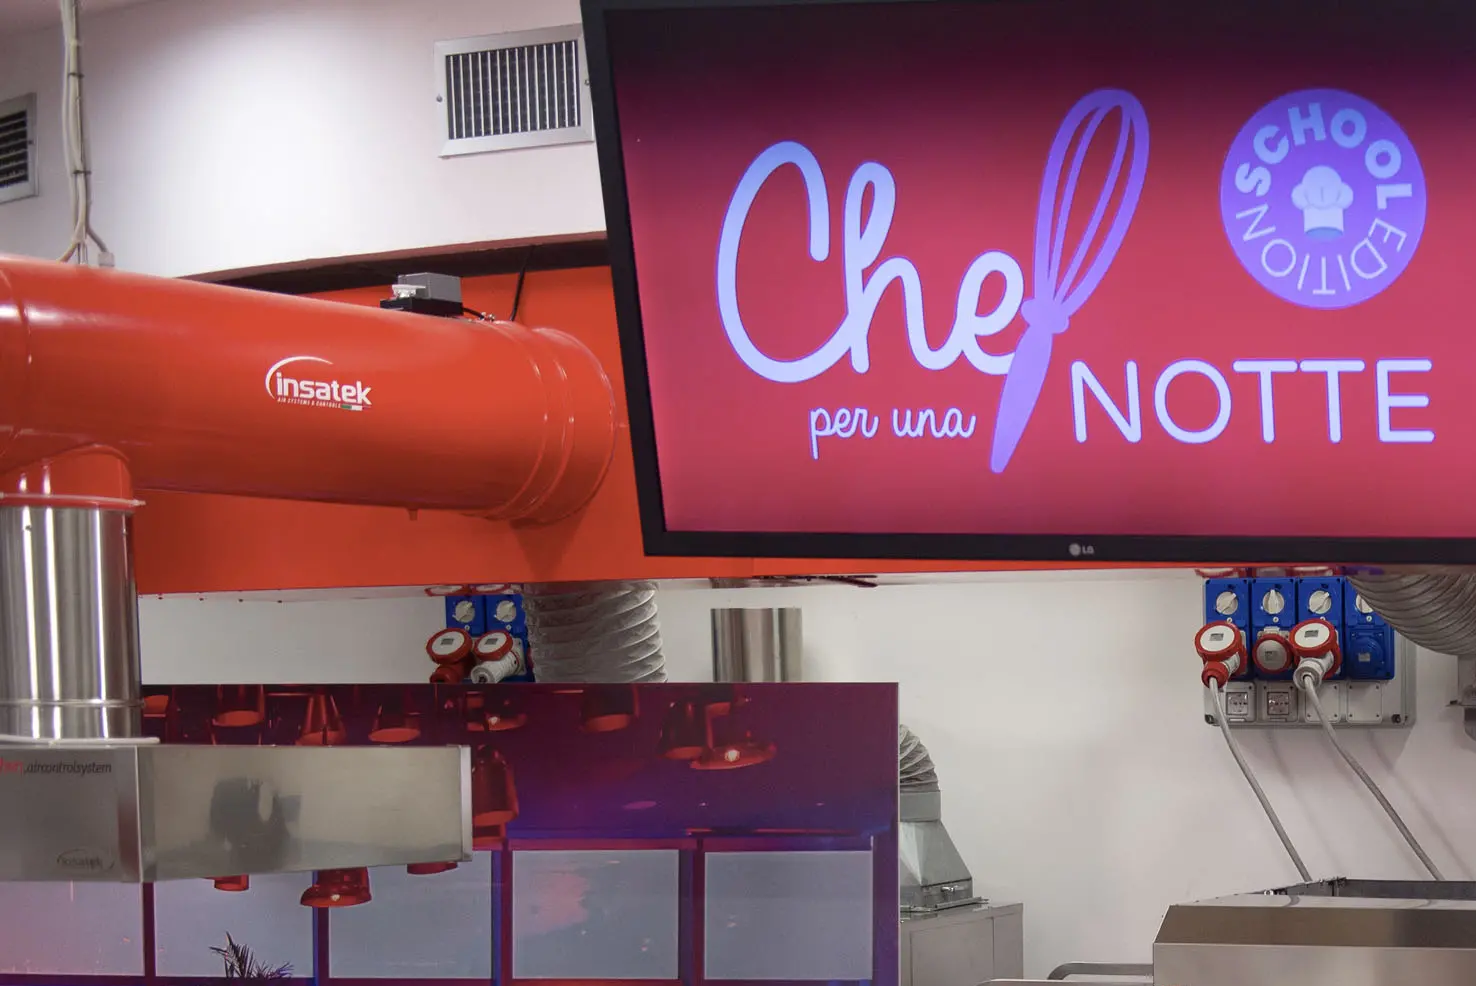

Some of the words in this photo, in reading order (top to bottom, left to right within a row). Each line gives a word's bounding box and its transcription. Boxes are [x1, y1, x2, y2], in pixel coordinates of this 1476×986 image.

[1235, 102, 1413, 211] SCHOOL
[1235, 202, 1408, 296] EDITION
[275, 371, 372, 406] insatek
[809, 403, 879, 460] per
[891, 406, 977, 440] una
[1069, 358, 1436, 444] NOTTE
